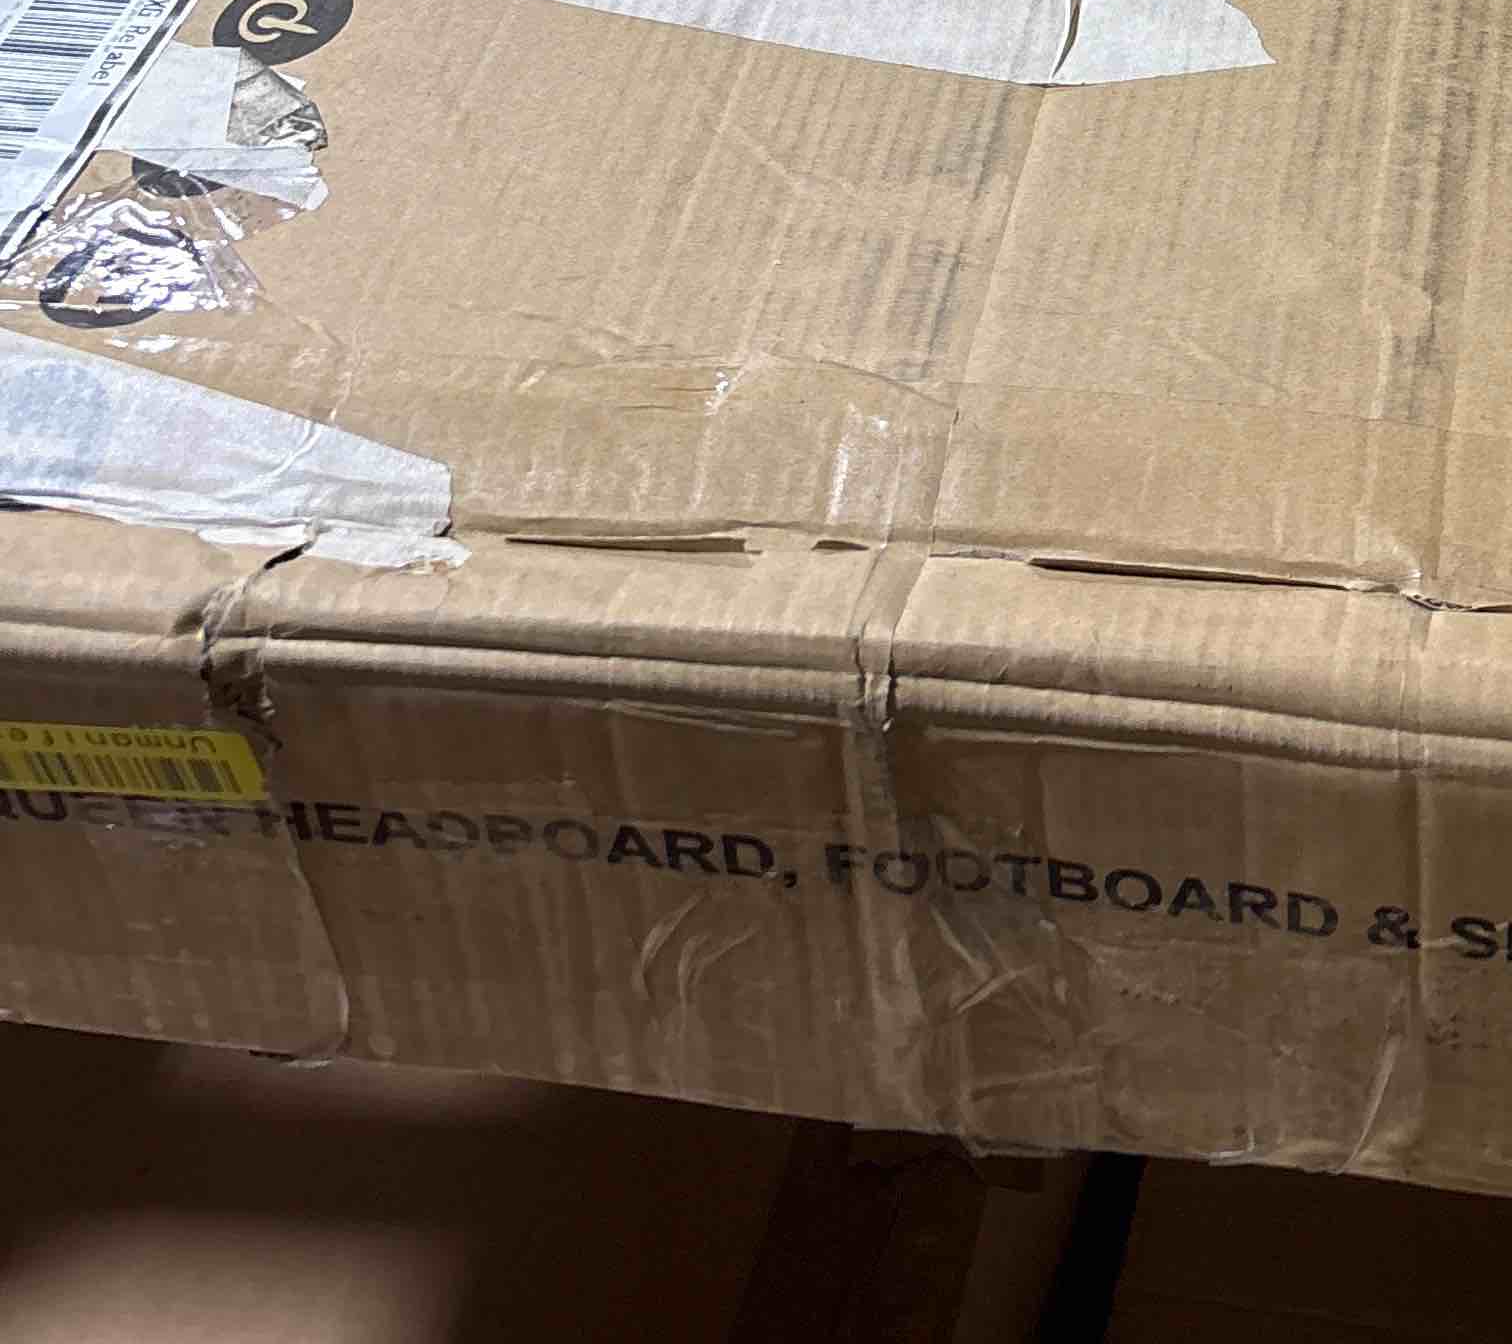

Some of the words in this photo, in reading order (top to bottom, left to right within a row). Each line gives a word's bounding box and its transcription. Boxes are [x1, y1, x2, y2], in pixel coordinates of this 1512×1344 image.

[0, 726, 217, 754] Unmanife
[824, 842, 1338, 938] FOOTBOARD
[1367, 904, 1421, 949] &
